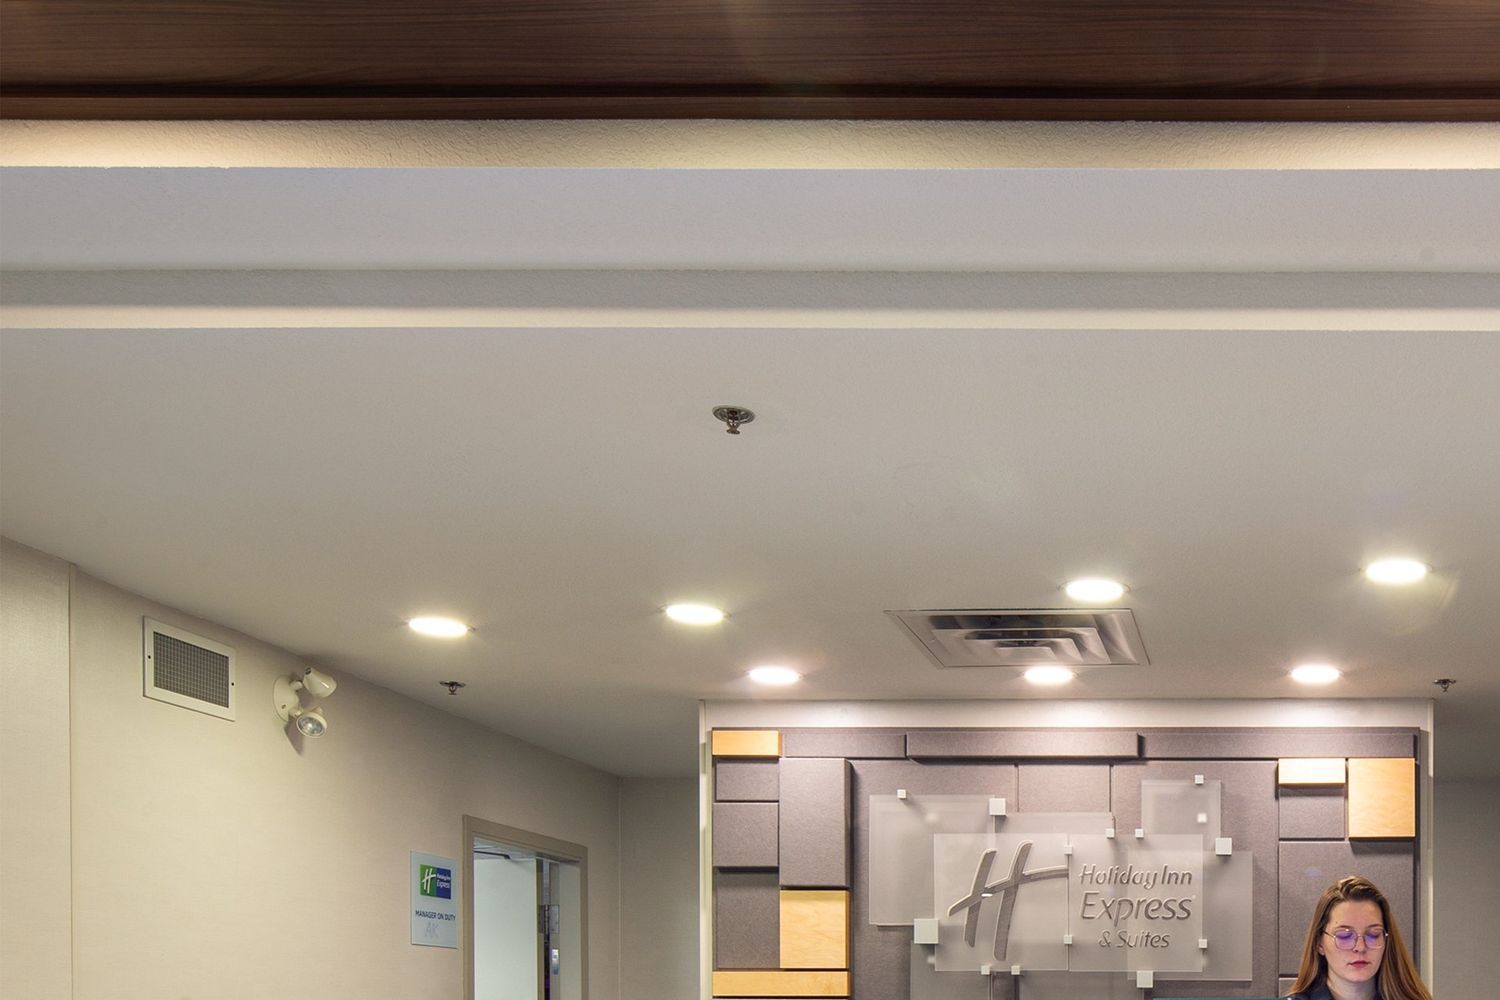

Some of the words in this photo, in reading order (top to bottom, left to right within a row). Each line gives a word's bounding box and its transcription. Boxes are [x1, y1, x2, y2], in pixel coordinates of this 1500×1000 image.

[1079, 864, 1158, 889] Holiday
[1161, 864, 1194, 885] Inn
[415, 909, 437, 919] MANAGER
[437, 912, 444, 920] ON
[444, 913, 456, 921] DUTY
[1080, 892, 1194, 927] Express
[1098, 931, 1111, 949] &
[1117, 930, 1171, 949] Suites
